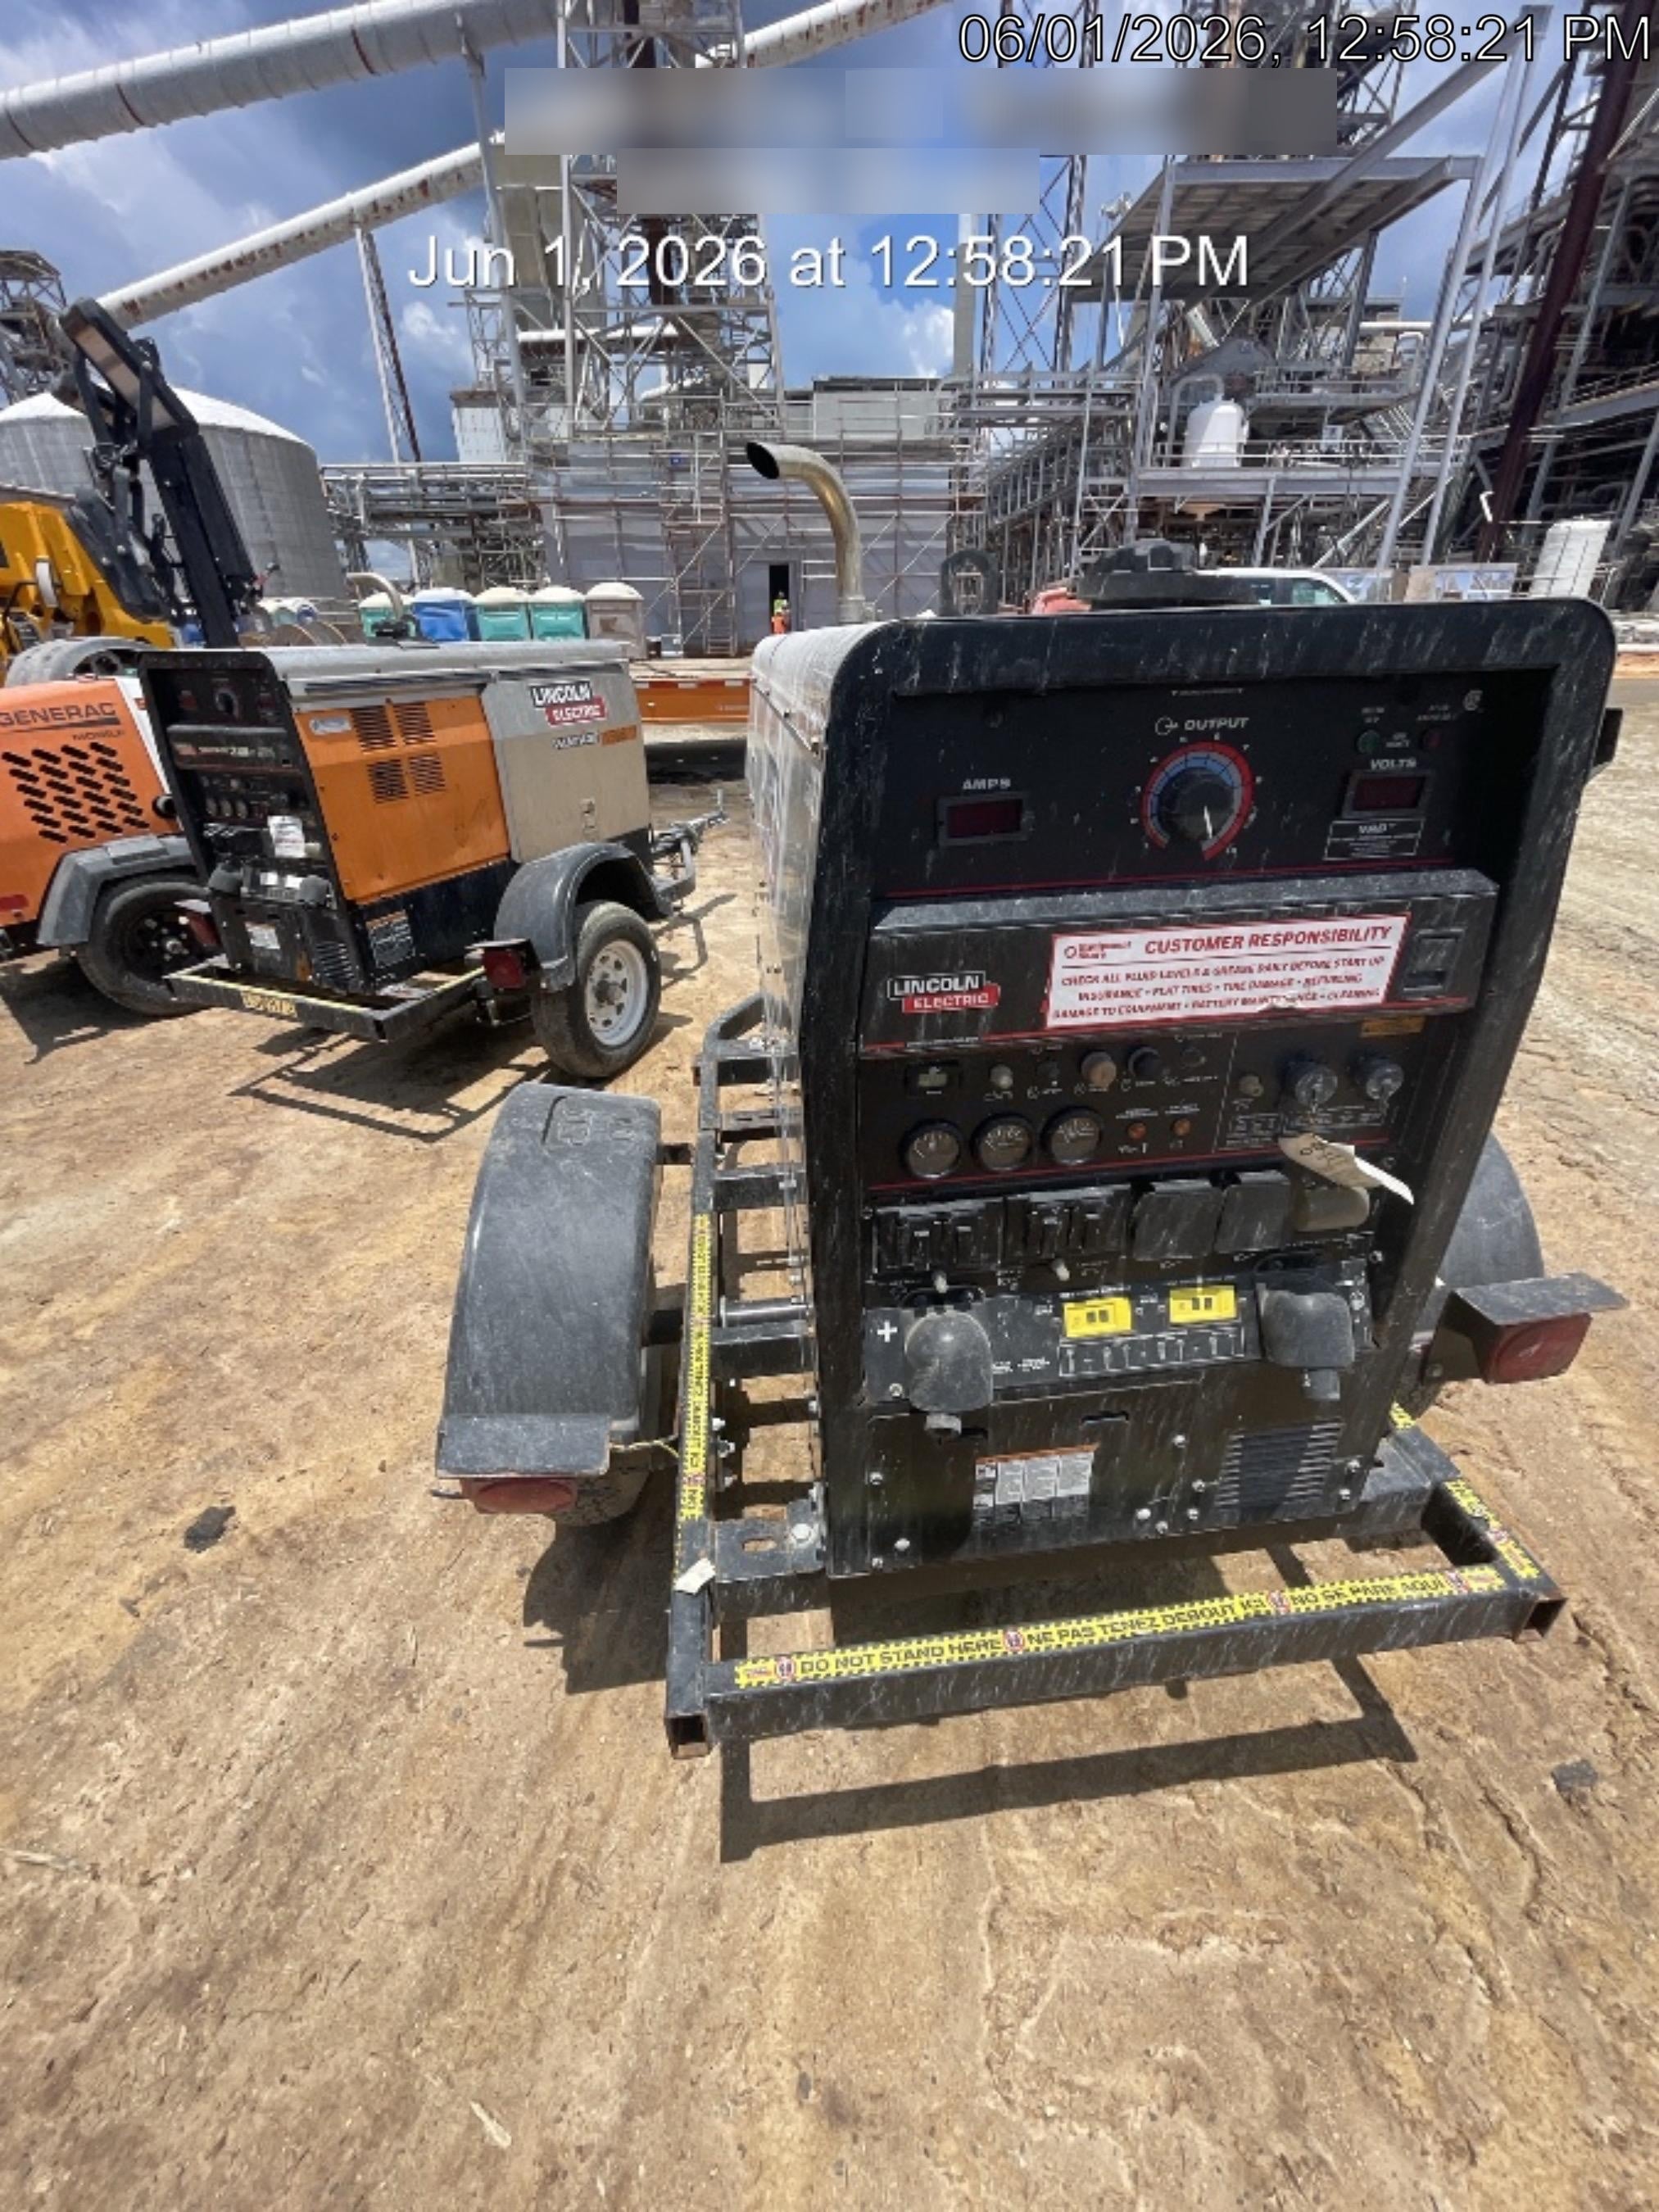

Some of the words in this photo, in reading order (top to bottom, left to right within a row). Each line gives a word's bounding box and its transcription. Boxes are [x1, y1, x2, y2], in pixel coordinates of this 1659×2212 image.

[533, 682, 591, 705] LINCOLN
[0, 702, 116, 726] GENERAC
[1184, 717, 1249, 731] OUTPUT
[1370, 758, 1417, 770] VOLTS
[963, 777, 1011, 791] AMPS
[1145, 936, 1244, 954] CUSTOMER
[1248, 926, 1392, 948] RESPONSIBILITY
[1101, 972, 1121, 984] ALL
[1160, 967, 1199, 980] LEVELS
[1335, 957, 1366, 968] START
[894, 974, 979, 996] LINCOLN
[913, 992, 989, 1009] ELECTRIC
[1101, 1007, 1117, 1017] TO
[1292, 1592, 1319, 1606] NO
[1027, 1630, 1054, 1645] NE
[1057, 1626, 1095, 1640] PAS
[801, 1658, 830, 1675] DO
[835, 1653, 874, 1670] NOT
[880, 1645, 944, 1664] STAND
[949, 1639, 1002, 1655] HERE
